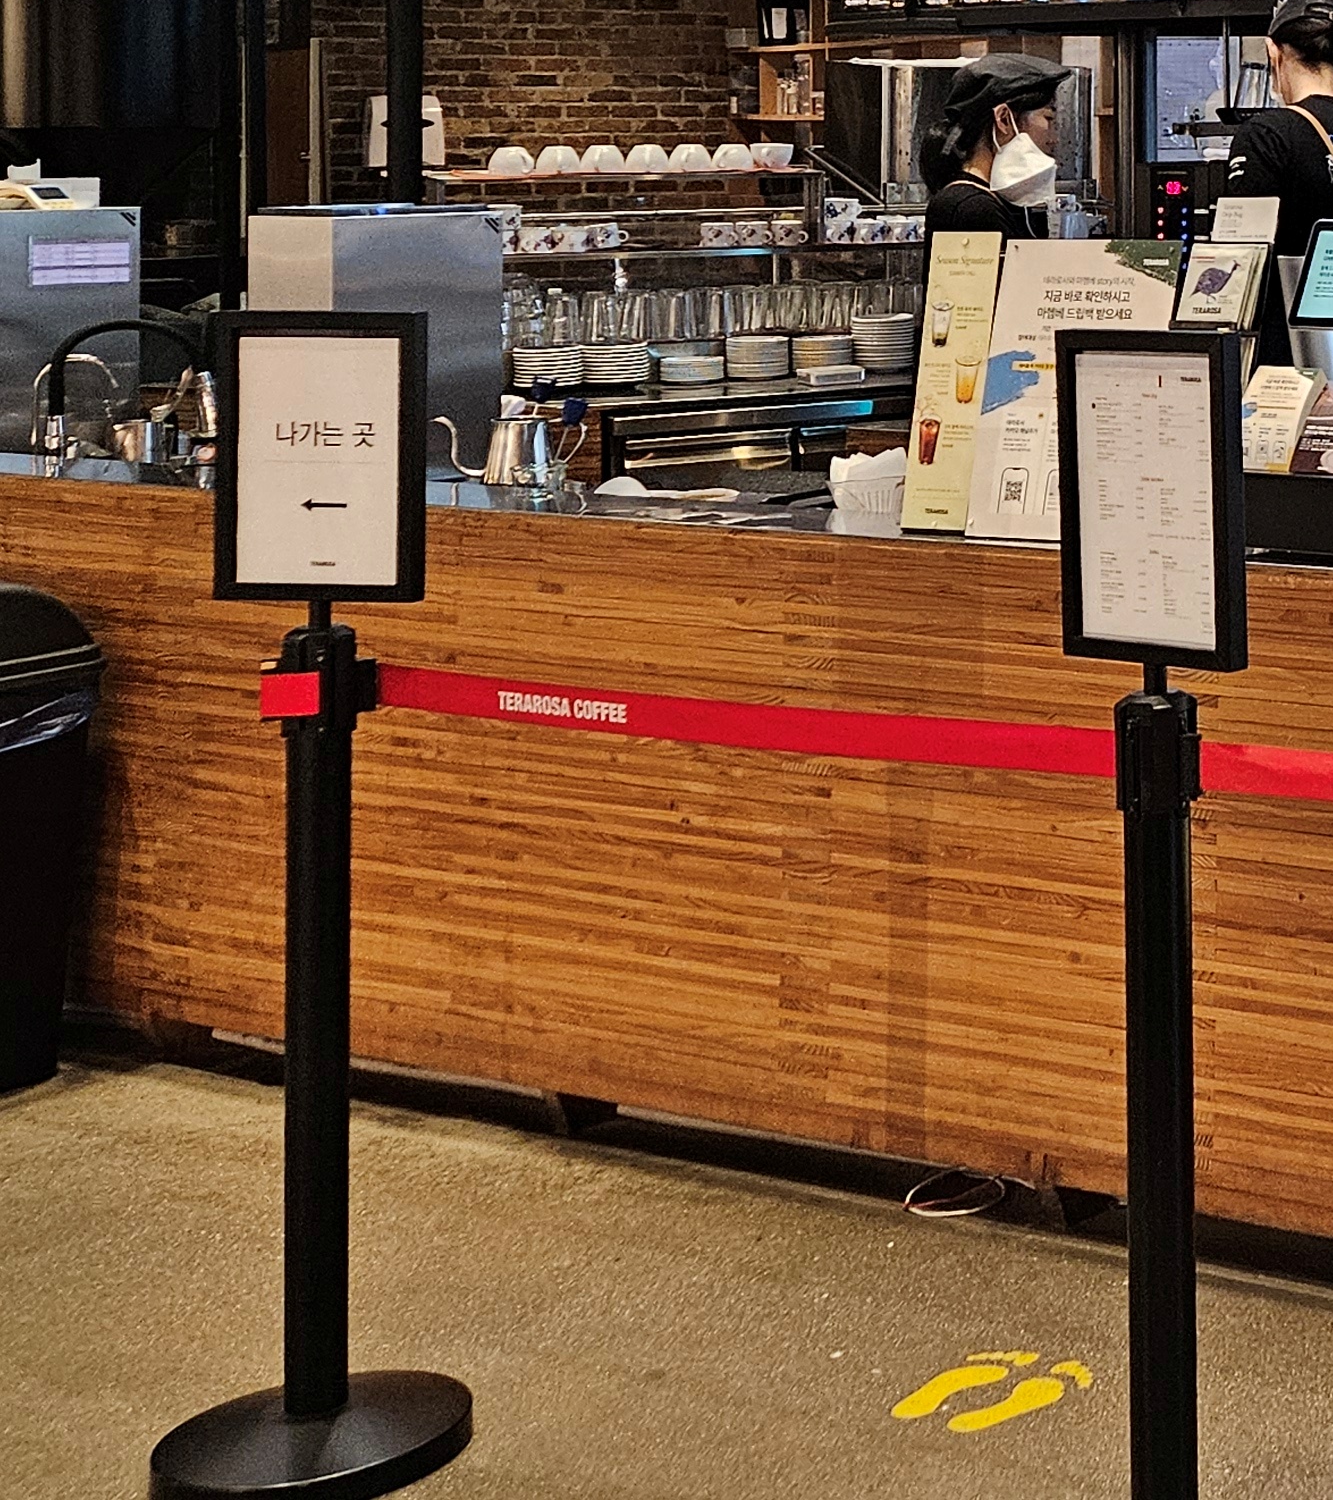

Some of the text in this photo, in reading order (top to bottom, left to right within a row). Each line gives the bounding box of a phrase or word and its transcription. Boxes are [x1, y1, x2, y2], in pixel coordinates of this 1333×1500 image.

[1044, 290, 1130, 303] 지금 바로 확인하시고
[276, 421, 376, 448] 나가는 곳
[498, 690, 628, 724] TERAROSA COFFEE
